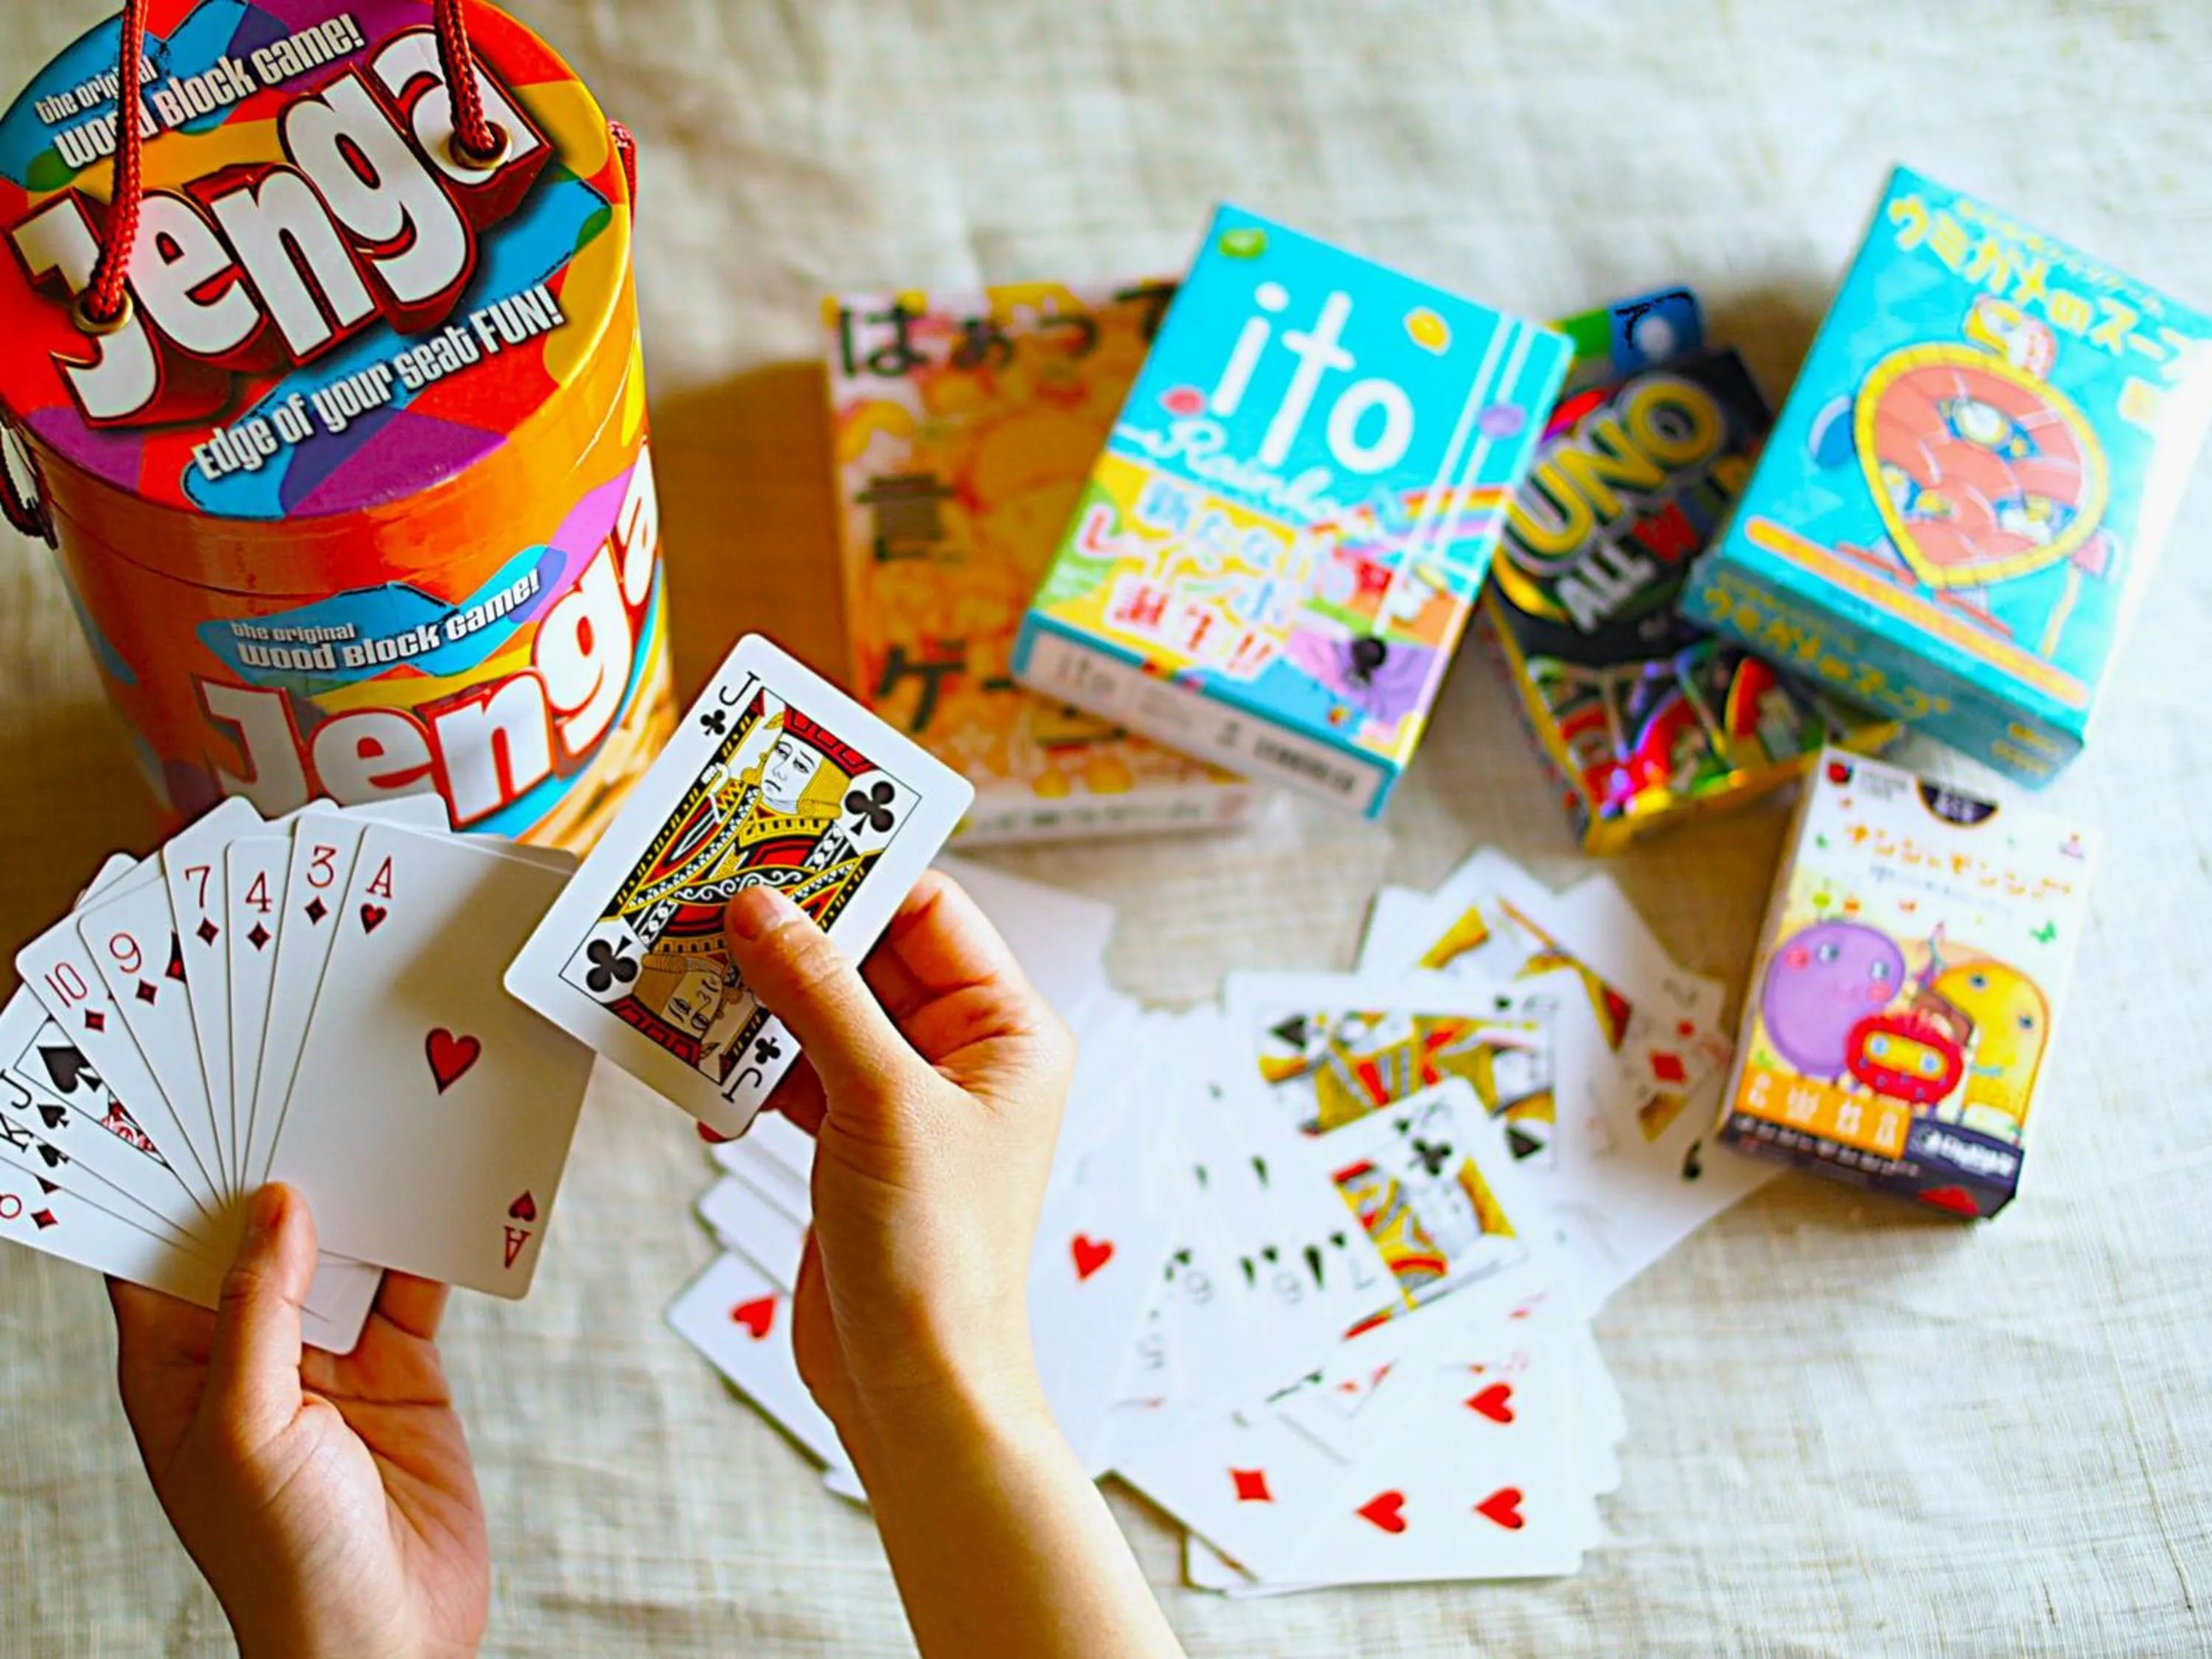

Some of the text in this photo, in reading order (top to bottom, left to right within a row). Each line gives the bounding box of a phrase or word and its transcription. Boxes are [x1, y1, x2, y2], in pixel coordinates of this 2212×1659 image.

[251, 13, 365, 86] Game!
[34, 90, 79, 125] the
[10, 24, 542, 419] Jenga
[191, 283, 566, 481] Edge of your seat FUN!
[1210, 280, 1416, 475] ito
[1504, 378, 1724, 554] UNO
[201, 444, 658, 824] Jenga
[231, 622, 270, 639] the
[272, 622, 356, 644] original
[237, 642, 336, 671] Wood
[719, 670, 761, 708] J
[184, 865, 212, 908] 7
[306, 846, 338, 888] 3
[366, 855, 394, 899] A
[245, 870, 273, 914] 4
[109, 932, 143, 974] 9
[44, 962, 89, 1008] 10
[720, 1069, 763, 1105] J
[503, 1224, 532, 1270] A
